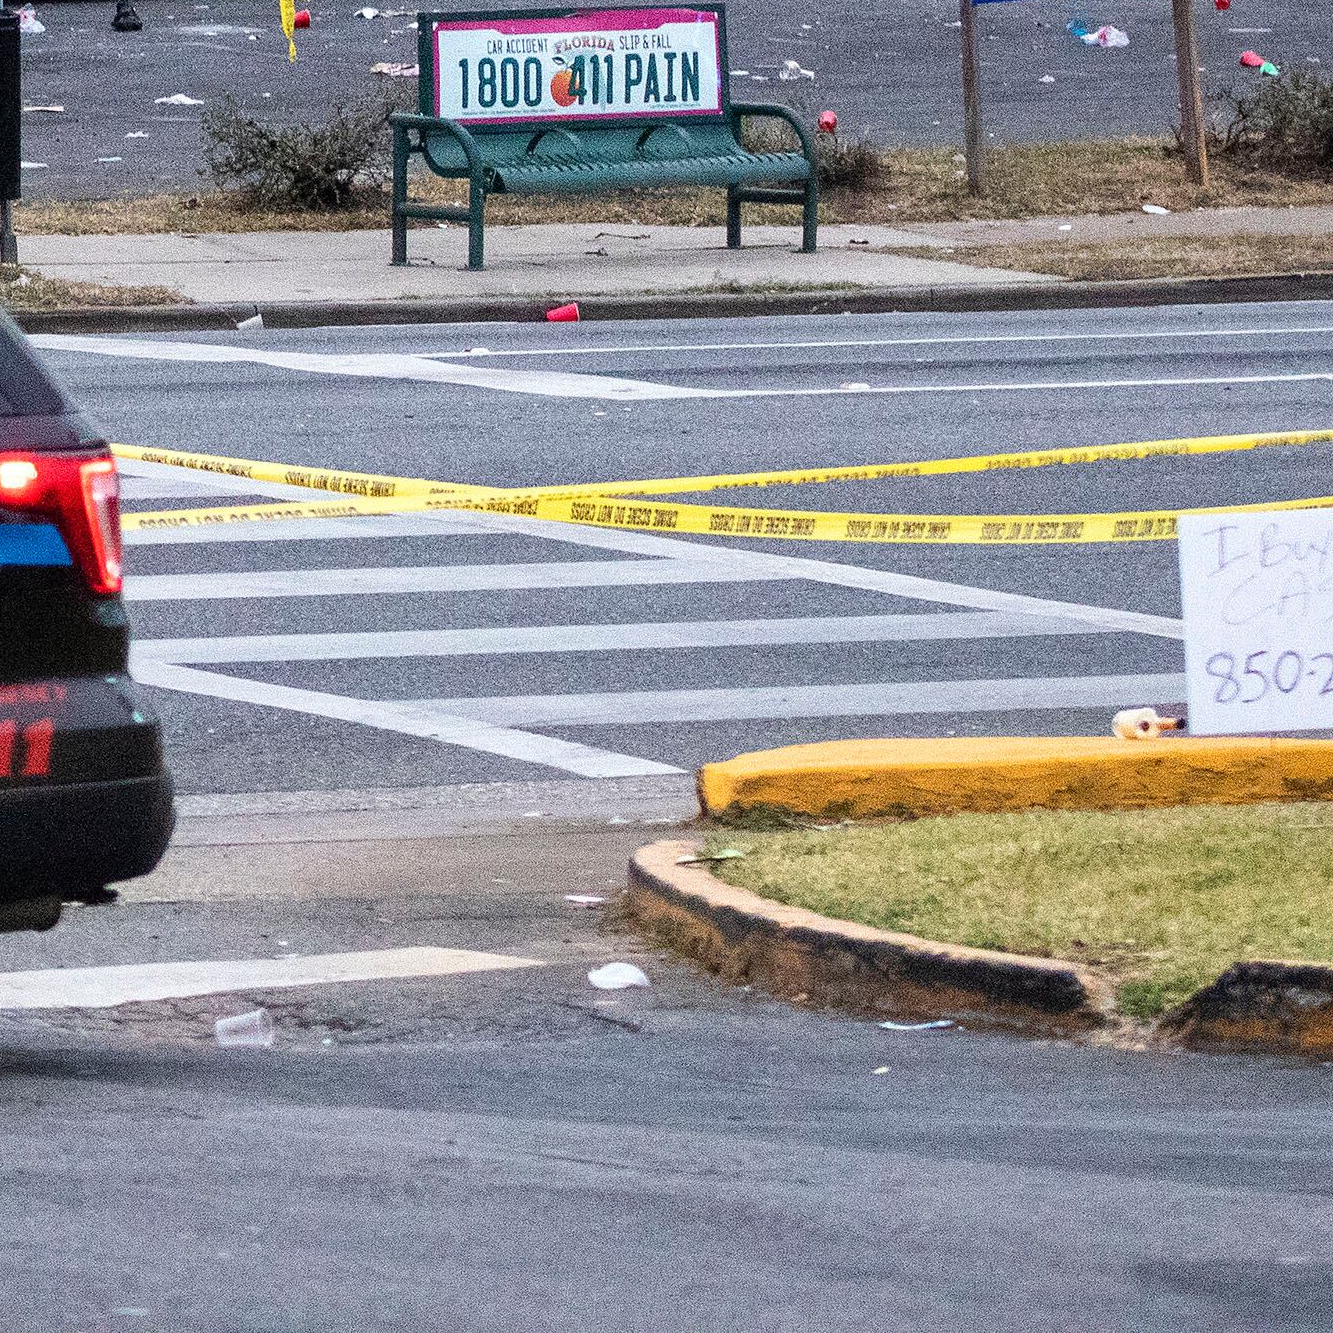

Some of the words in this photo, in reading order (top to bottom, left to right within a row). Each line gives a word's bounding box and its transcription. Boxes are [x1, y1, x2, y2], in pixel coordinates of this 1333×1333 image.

[487, 39, 504, 55] CAR
[505, 38, 548, 54] ACCIDENT
[553, 36, 616, 54] FLORIDA
[619, 35, 639, 50] SLIP
[642, 35, 649, 49] &
[651, 34, 671, 49] FALL
[568, 55, 614, 106] 411
[624, 51, 700, 105] PAIN
